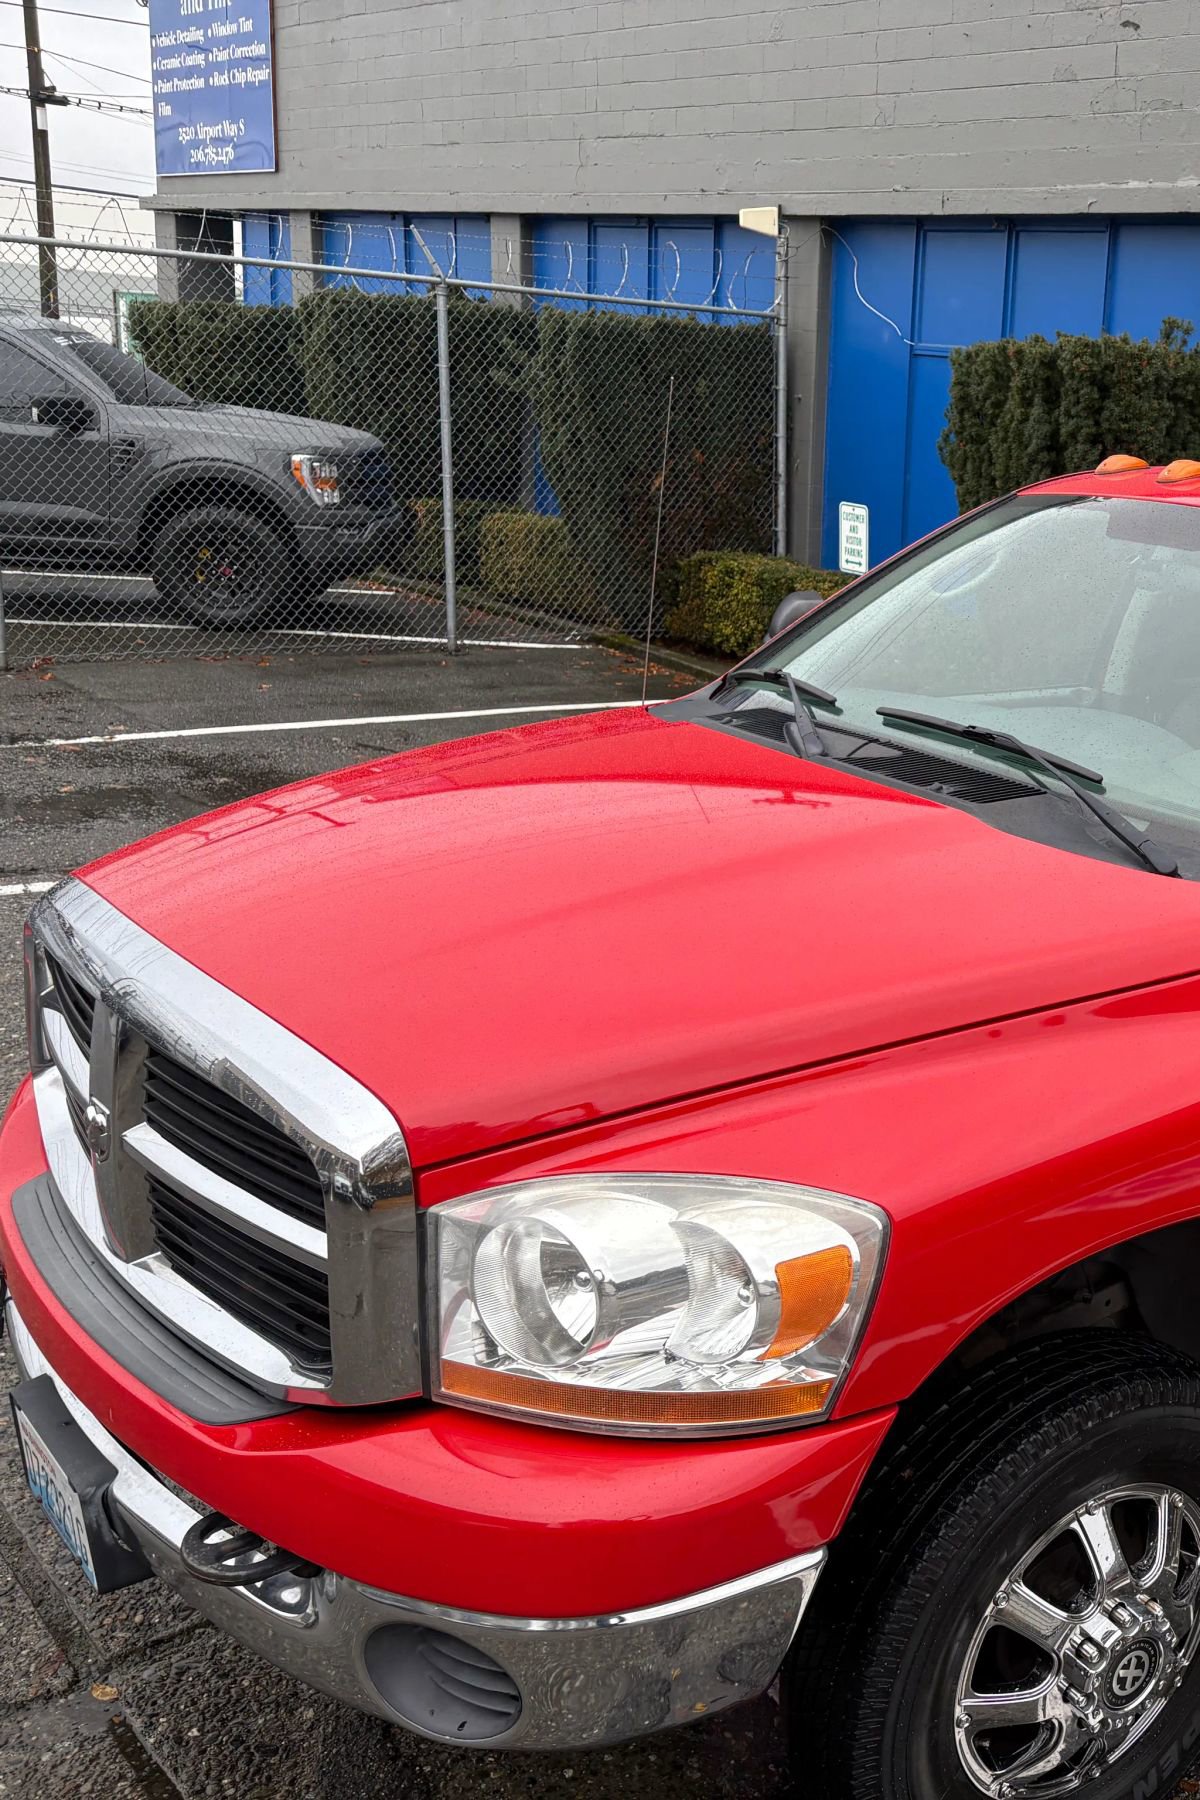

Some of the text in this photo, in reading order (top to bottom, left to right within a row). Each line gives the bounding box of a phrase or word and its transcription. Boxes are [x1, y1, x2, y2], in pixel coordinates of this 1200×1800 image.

[156, 27, 204, 47] Vehicle Detailing
[212, 17, 253, 37] Window Tint
[157, 51, 205, 70] Ceramic Coating
[213, 40, 266, 62] Paint Correction
[158, 74, 205, 94] Paint Protection
[213, 64, 270, 88] Rock Chip Repair
[158, 101, 172, 117] Film
[178, 118, 245, 145] 2520 Airport Way S
[843, 511, 865, 524] CUSTOMER
[849, 524, 859, 535] AND
[845, 546, 863, 559] PARKING
